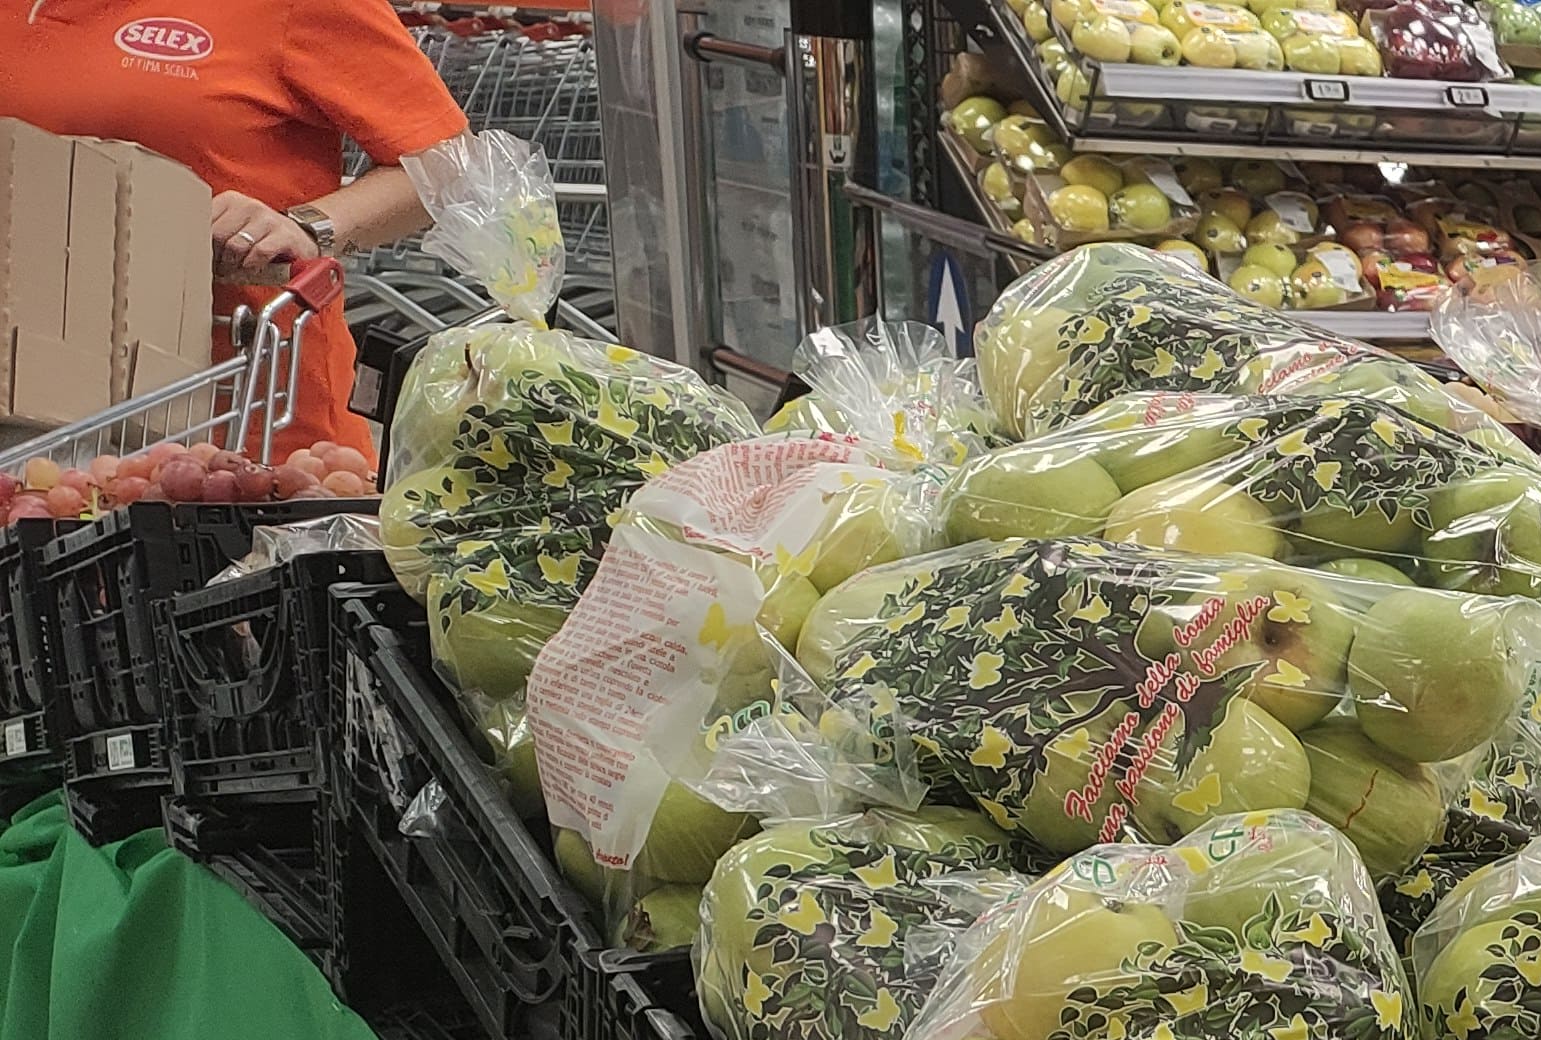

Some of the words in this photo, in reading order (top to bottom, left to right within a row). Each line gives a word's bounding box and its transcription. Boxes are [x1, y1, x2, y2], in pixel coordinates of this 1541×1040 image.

[124, 24, 206, 54] SELEX
[1064, 711, 1139, 823] Facciamo
[1136, 652, 1181, 708] della
[1116, 702, 1179, 806] passione
[1175, 674, 1199, 702] di
[1191, 596, 1271, 675] famiglia
